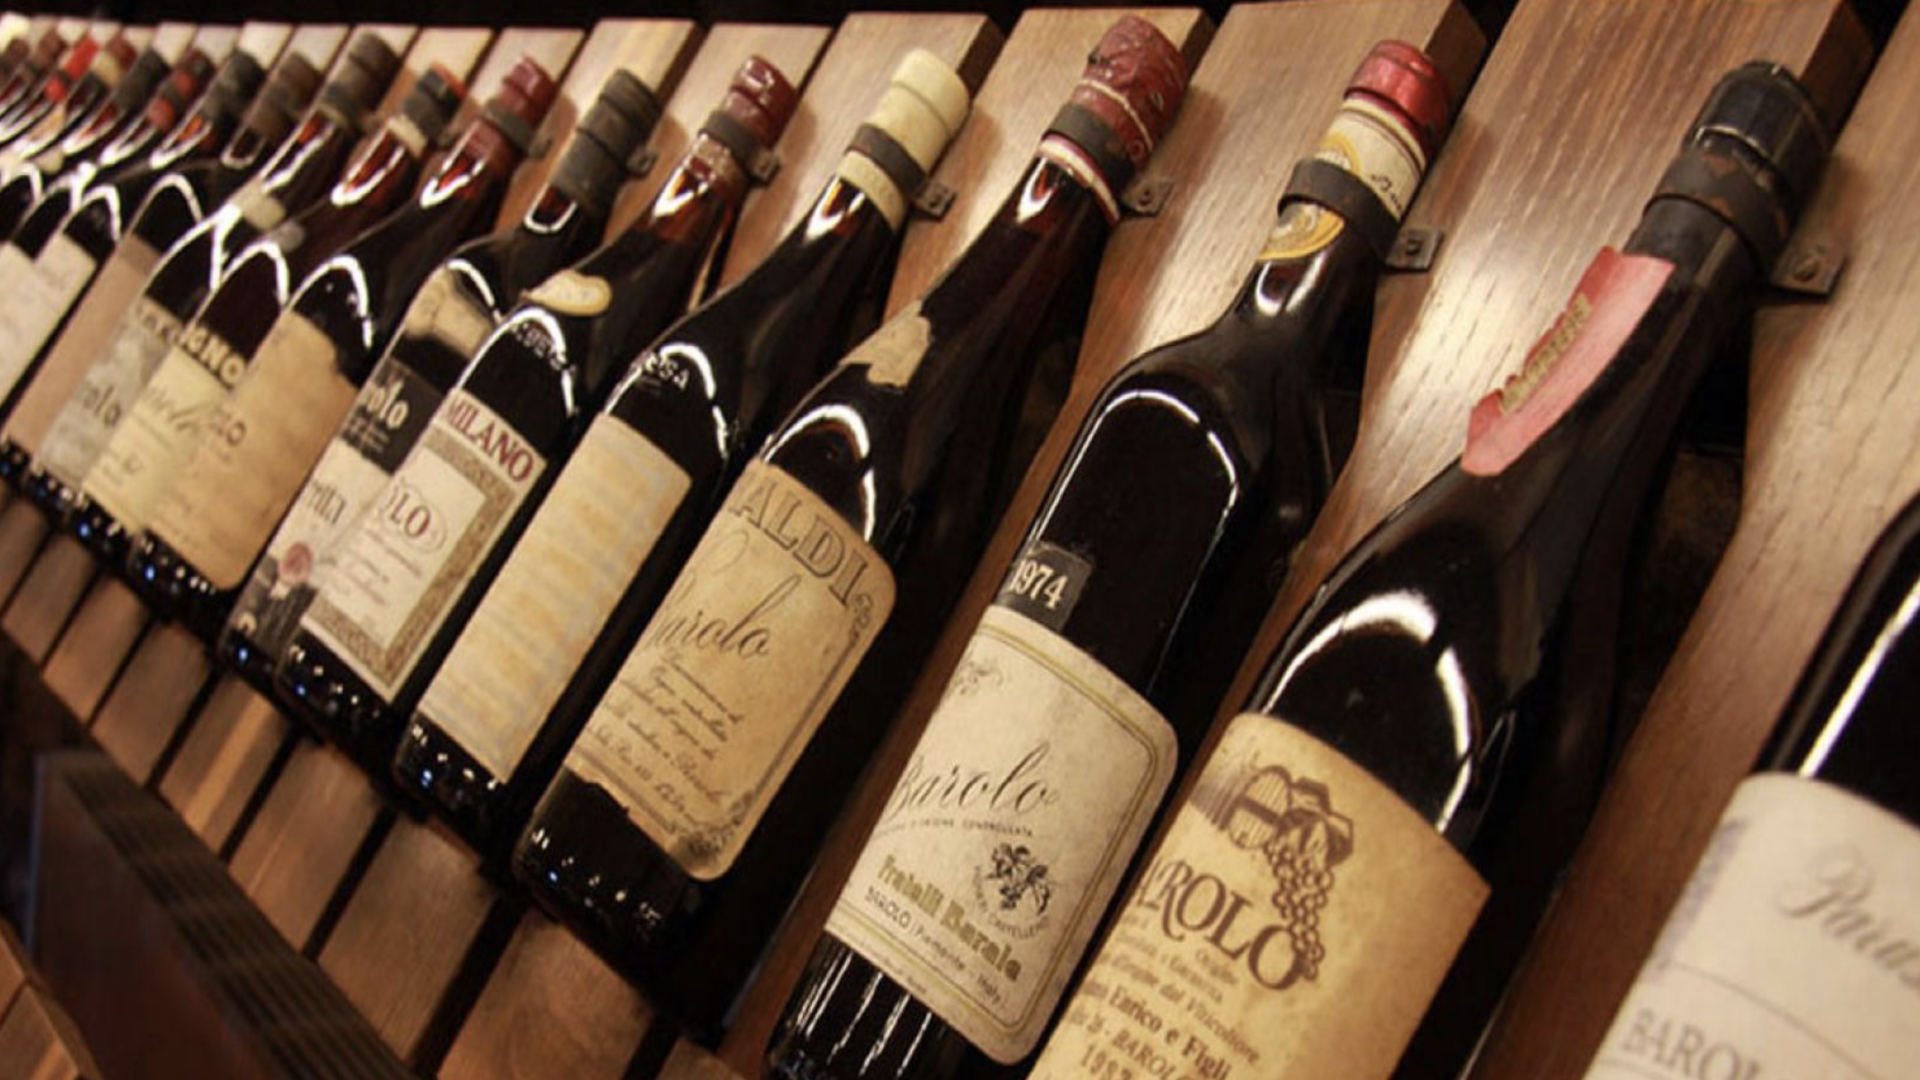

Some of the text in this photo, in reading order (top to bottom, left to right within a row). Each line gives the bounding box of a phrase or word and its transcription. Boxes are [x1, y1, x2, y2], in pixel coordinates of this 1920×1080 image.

[443, 396, 534, 484] MILANO
[1006, 556, 1069, 612] 1974
[877, 853, 945, 919] Fratelli
[940, 899, 1022, 983] Barale
[1108, 984, 1164, 1034] Enrico
[1164, 1027, 1180, 1046] e
[1181, 1035, 1233, 1080] Figli
